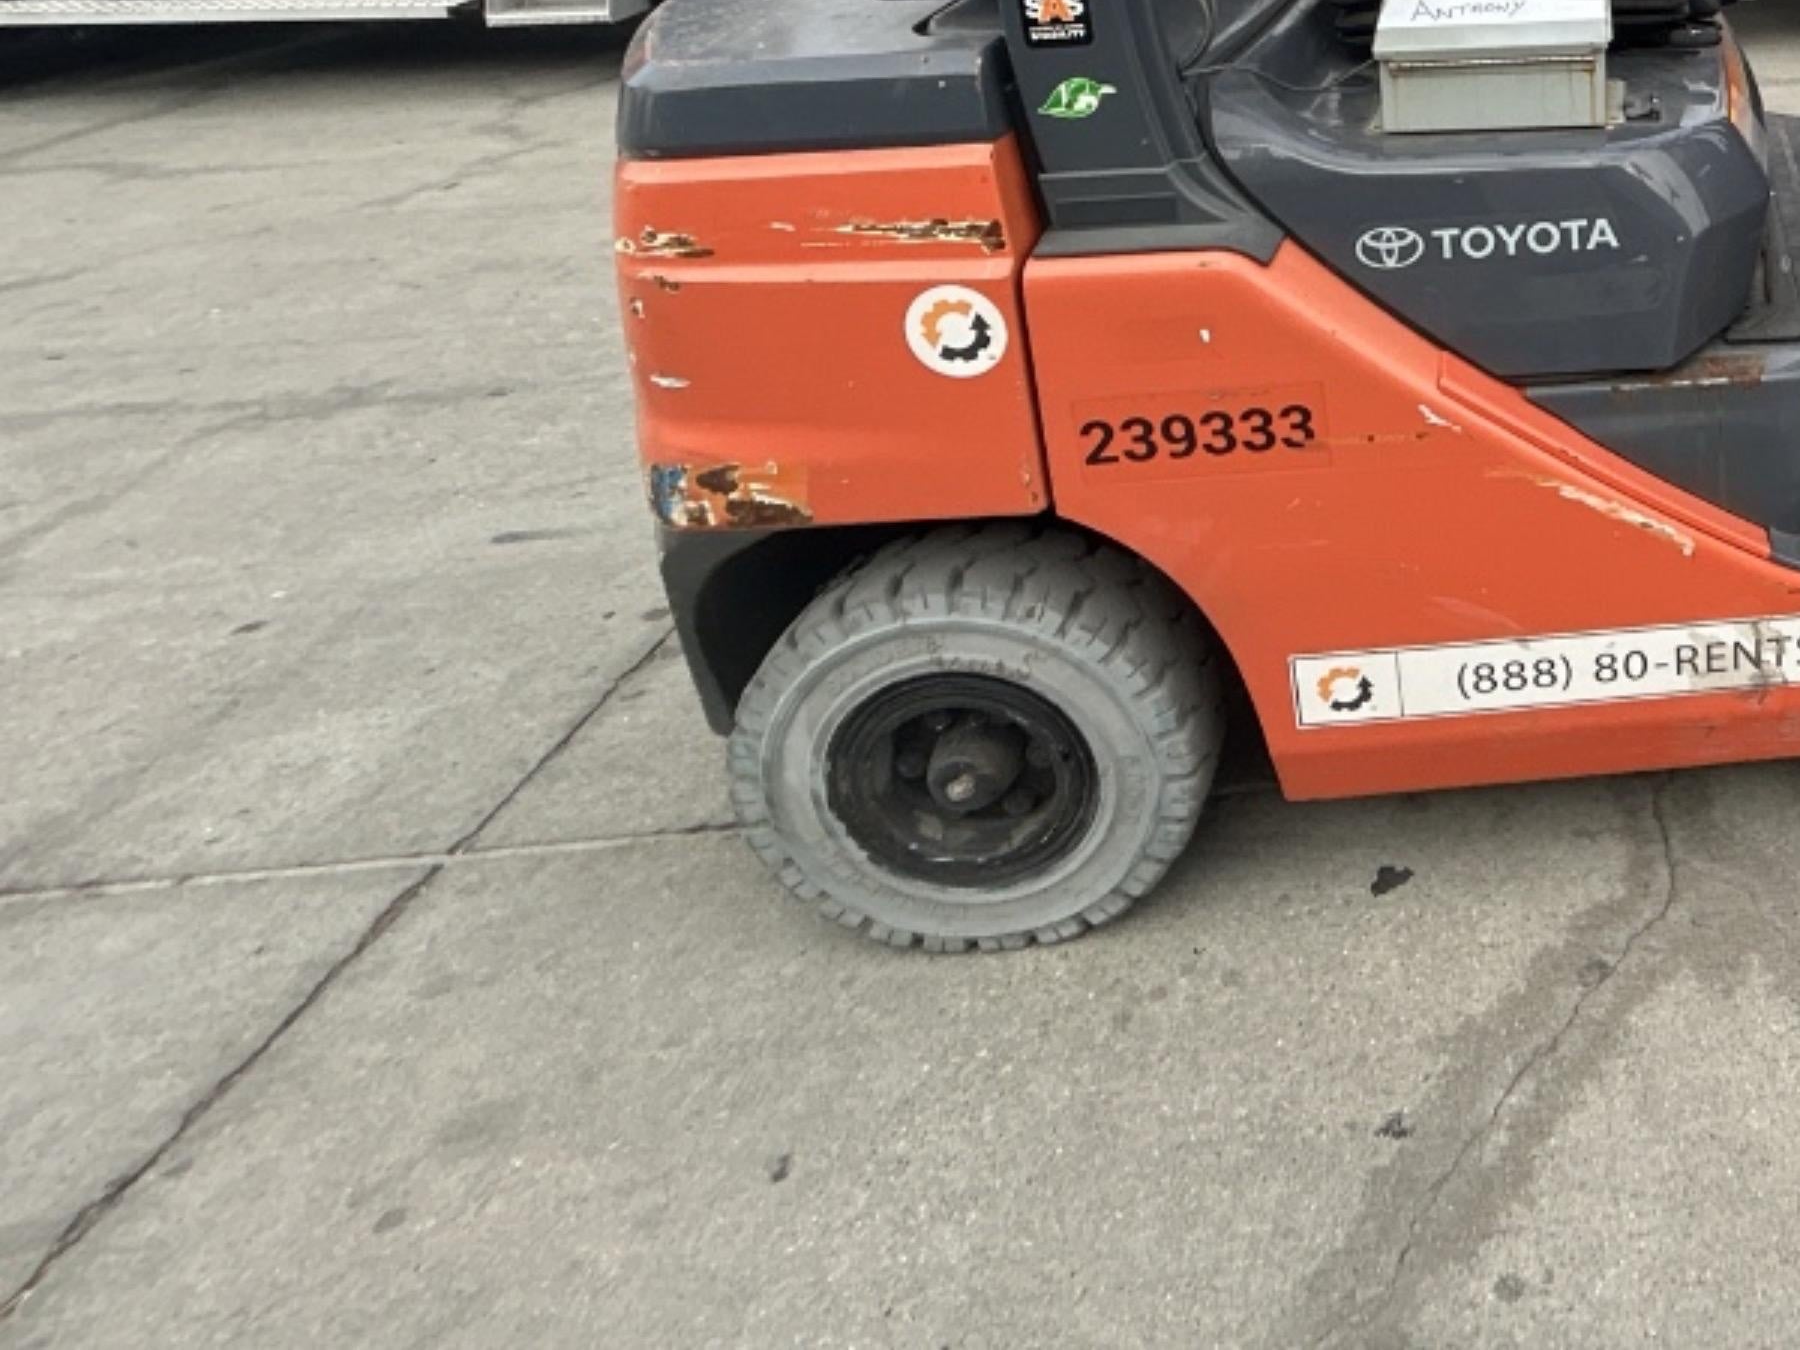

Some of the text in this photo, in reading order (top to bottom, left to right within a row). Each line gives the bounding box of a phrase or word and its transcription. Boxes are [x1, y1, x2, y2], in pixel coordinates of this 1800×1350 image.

[1430, 217, 1620, 259] TOYOTA
[1079, 404, 1316, 466] 239333
[1456, 653, 1575, 700] (888)
